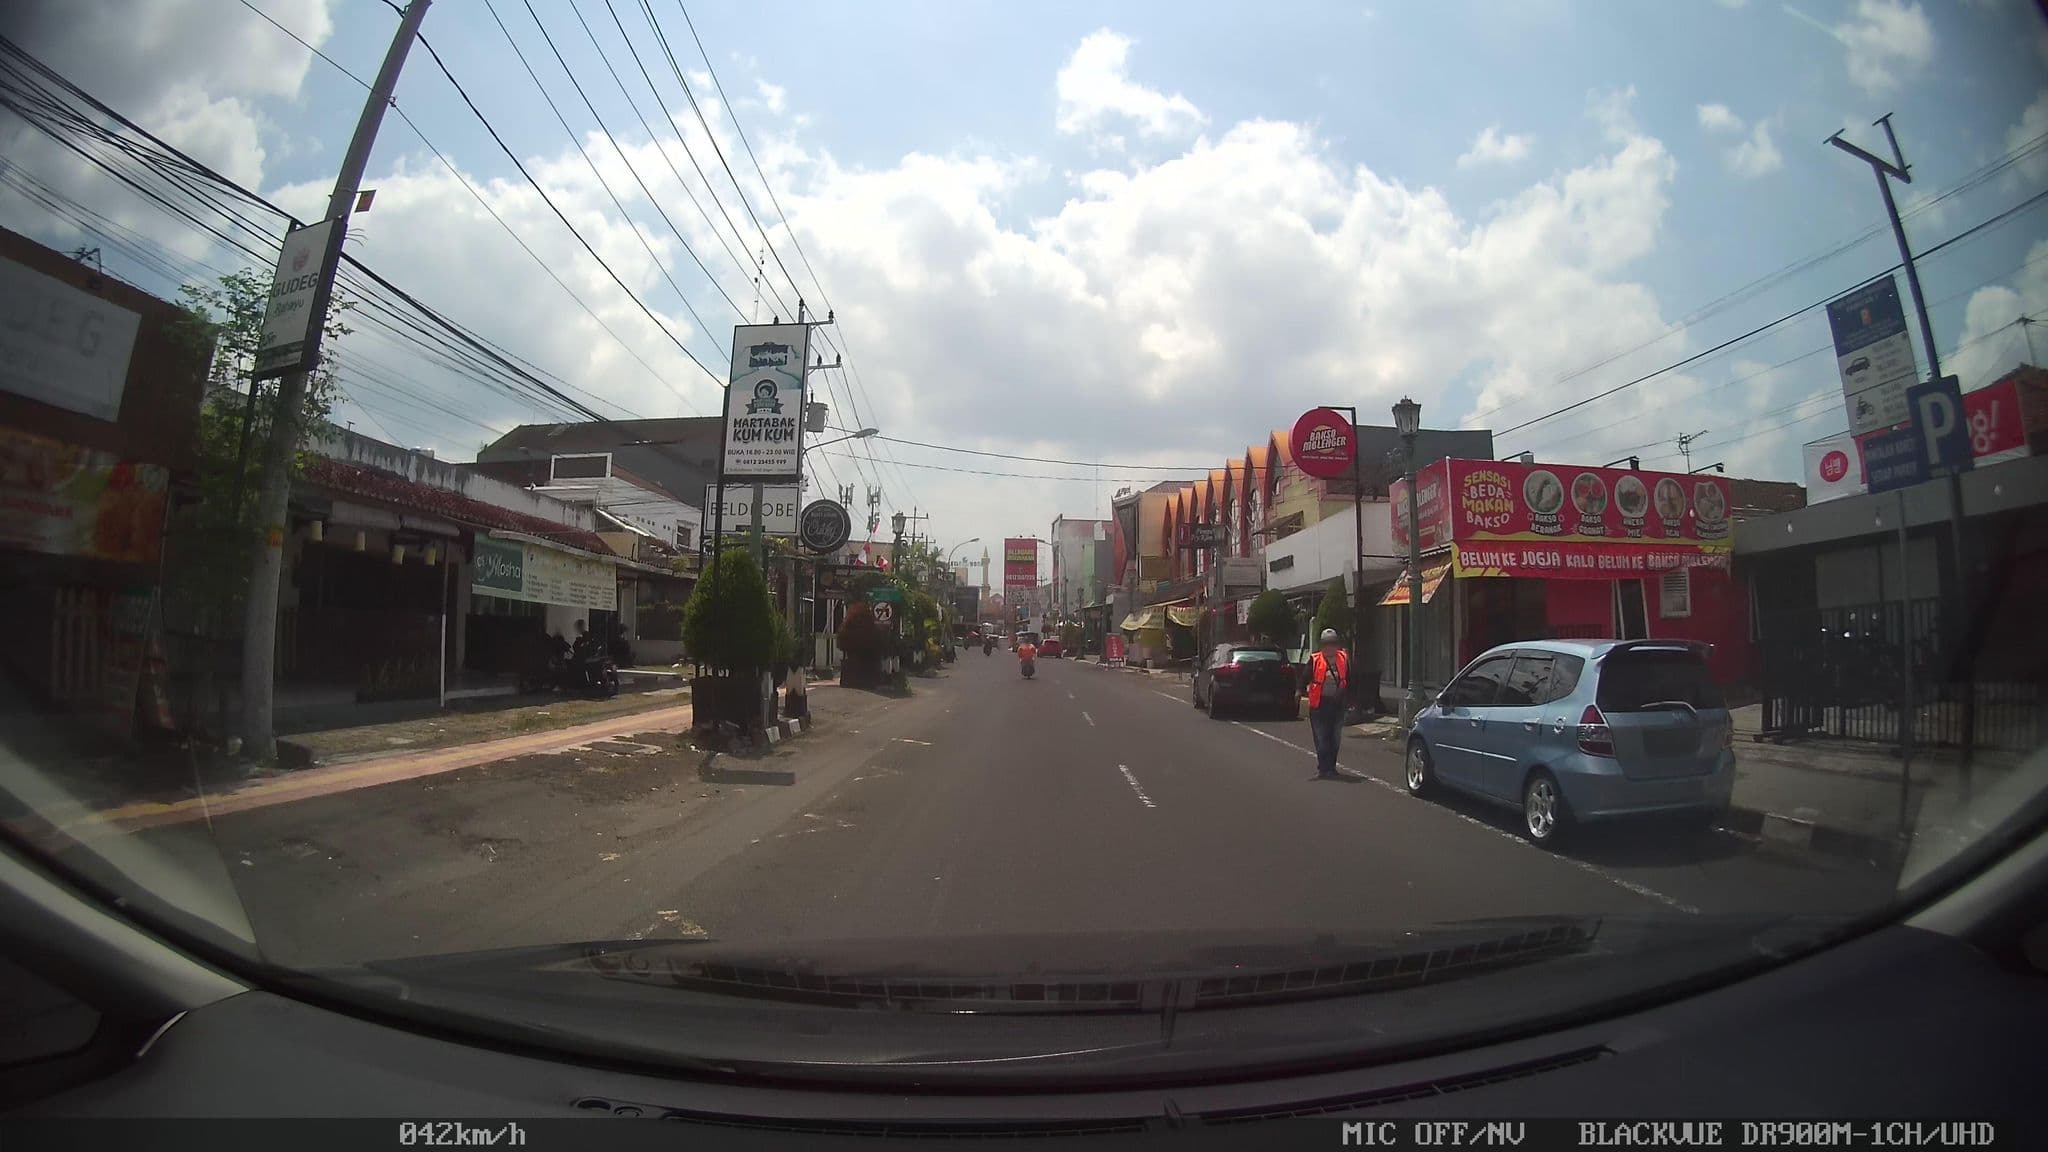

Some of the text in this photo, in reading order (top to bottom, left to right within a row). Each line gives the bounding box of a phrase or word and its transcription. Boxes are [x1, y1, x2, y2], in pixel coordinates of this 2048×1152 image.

[272, 273, 320, 298] GUDEG
[733, 417, 796, 428] MARTABAK
[1918, 391, 1956, 464] P
[733, 428, 794, 443] KUM KUM
[1302, 436, 1346, 451] MOLENGER
[1310, 429, 1336, 442] BAKSO
[1463, 470, 1512, 491] SENSASI
[1470, 484, 1505, 499] BEDA
[1462, 496, 1514, 513] MAKAN
[1466, 511, 1510, 528] BAKSO
[1534, 514, 1557, 522] BAKSO
[1460, 552, 1500, 566] BELUM
[1502, 552, 1517, 566] KE
[1521, 551, 1560, 567] JOGJA
[1565, 554, 1595, 568] KALO
[1598, 555, 1630, 569] BELUM
[1632, 556, 1644, 569] KE
[1648, 554, 1680, 568] BAKSO
